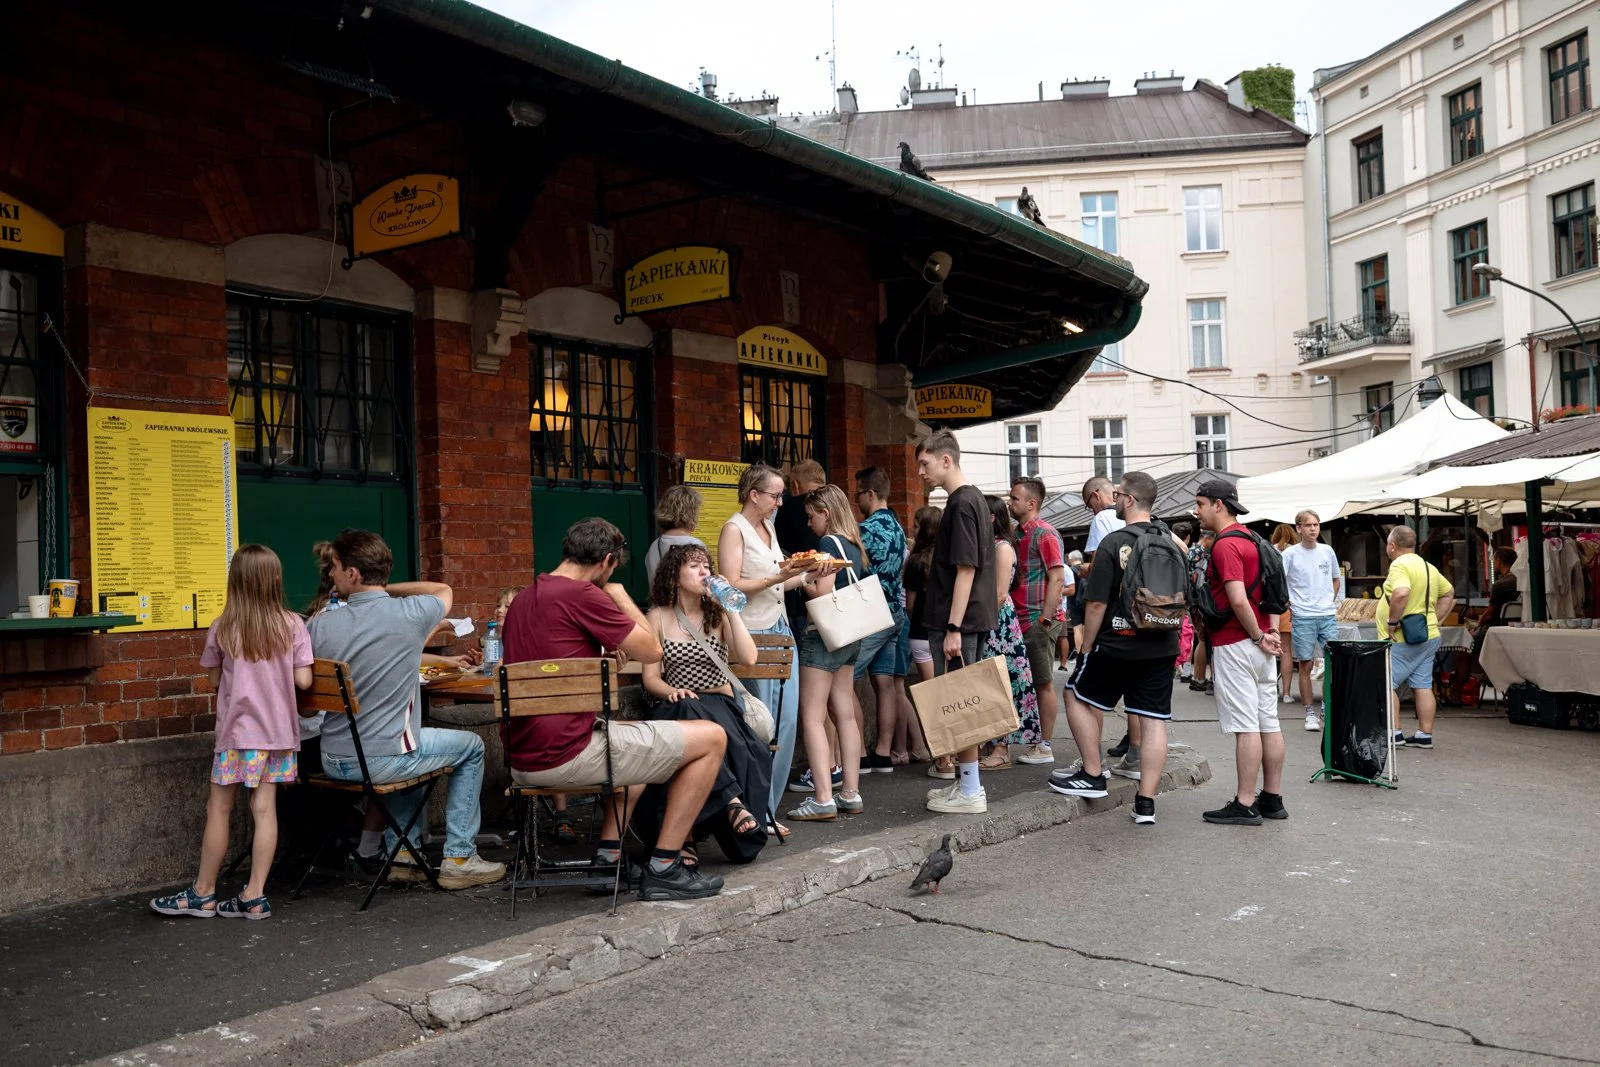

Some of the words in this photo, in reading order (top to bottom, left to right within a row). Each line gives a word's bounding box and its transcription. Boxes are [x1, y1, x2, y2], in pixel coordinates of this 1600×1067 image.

[387, 219, 426, 232] KRÓLOWA
[627, 259, 727, 292] ZAPIEKANKI
[630, 292, 665, 307] PIECYK
[763, 333, 790, 344] Piecyk
[144, 423, 185, 432] ZAPIEKANKI
[186, 426, 229, 435] KRÓLEWSKIE
[1145, 613, 1181, 625] Reebok
[942, 695, 981, 716] RYŁKO
